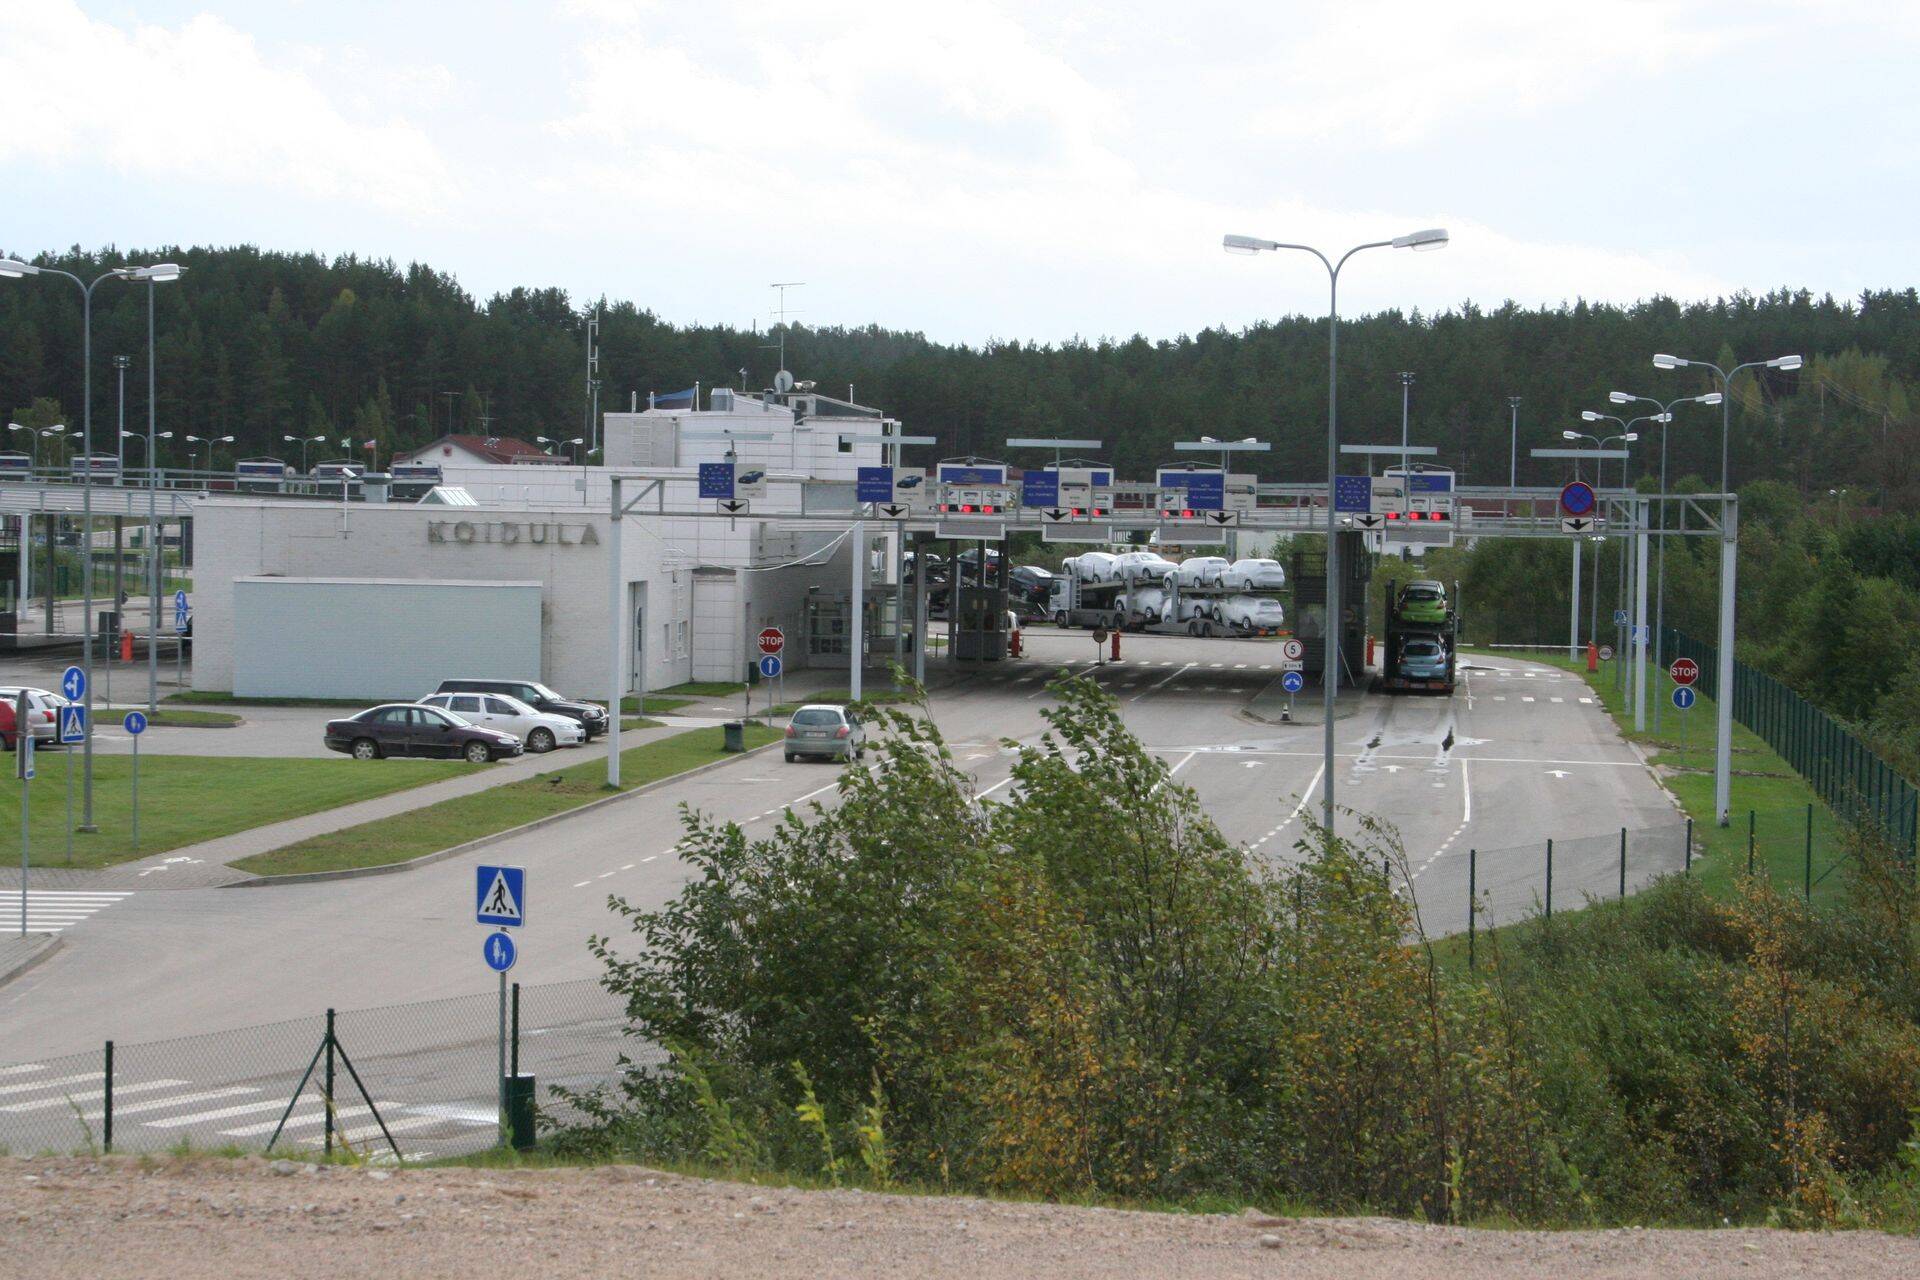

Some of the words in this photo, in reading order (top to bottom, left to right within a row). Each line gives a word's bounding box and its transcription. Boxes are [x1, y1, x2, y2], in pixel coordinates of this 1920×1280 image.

[428, 521, 599, 545] KOIDULA
[760, 636, 783, 646] STOP
[1290, 645, 1296, 654] 5
[1671, 667, 1696, 677] STOP
